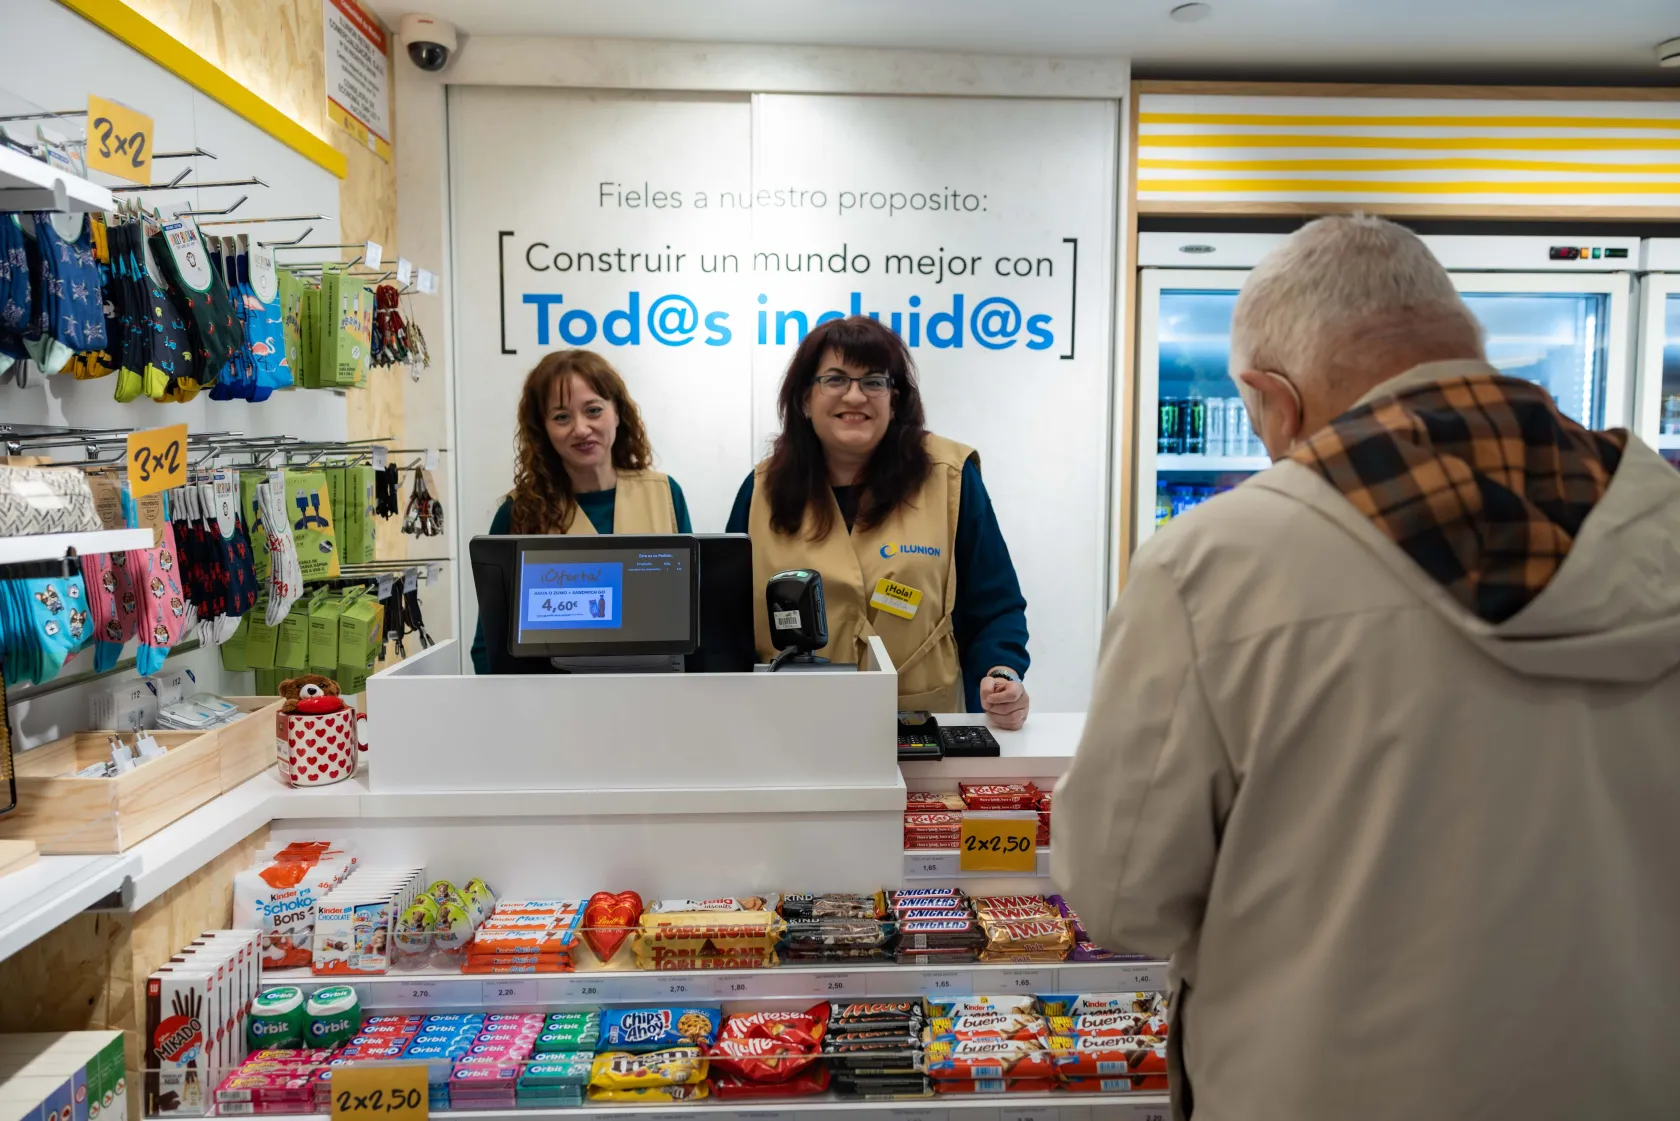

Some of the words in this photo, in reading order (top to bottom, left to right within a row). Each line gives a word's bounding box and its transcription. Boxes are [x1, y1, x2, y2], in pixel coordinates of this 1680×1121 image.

[94, 117, 145, 168] 3x2
[599, 182, 682, 209] Fieles
[694, 191, 708, 209] a
[720, 185, 827, 209] nuestro
[839, 186, 988, 217] proposito:
[525, 242, 686, 273] Construir
[701, 253, 739, 273] un
[753, 243, 870, 274] mundo
[885, 246, 982, 285] mejor
[995, 256, 1053, 278] con
[522, 291, 733, 347] Tod@s
[134, 440, 180, 482] 3x2
[900, 544, 941, 557] ILUNION
[885, 583, 913, 599] ¡Hola!
[541, 598, 578, 613] 4,60€
[964, 835, 1031, 854] 2x2,50
[271, 891, 297, 901] Kinder
[897, 888, 953, 896] SNICKERS
[784, 894, 813, 902] KIND
[899, 898, 957, 907] SNICKERS
[979, 895, 1044, 910] TWIX
[318, 906, 343, 914] Kinder
[907, 909, 966, 918] SNICKERS
[984, 906, 1051, 921] TWIX
[273, 911, 306, 927] Bons
[907, 921, 968, 930] SNICKERS
[998, 920, 1067, 941] TWIX
[266, 990, 294, 1000] Orbit
[319, 989, 348, 999] Orbit
[964, 1003, 985, 1011] Kinder
[1082, 1000, 1107, 1008] Kinder
[369, 1015, 399, 1024] Orbit
[430, 1014, 459, 1022] Orbit
[622, 1011, 663, 1030] Chips
[963, 1016, 1007, 1028] bueno
[1081, 1014, 1131, 1028] bueno
[252, 1021, 289, 1035] Orbit
[312, 1019, 350, 1035] Orbit
[364, 1025, 395, 1033] Orbit
[425, 1024, 455, 1032] Orbit
[487, 1023, 517, 1031] Orbit
[549, 1022, 579, 1031] Orbit
[153, 1017, 202, 1061] MIKADO
[352, 1036, 383, 1045] Orbit
[416, 1035, 448, 1043] Orbit
[479, 1034, 510, 1042] Orbit
[542, 1032, 573, 1041] Orbit
[1082, 1036, 1134, 1048] bueno
[410, 1046, 441, 1054] Orbit
[473, 1044, 505, 1053] Orbit
[962, 1043, 1008, 1053] bueno
[462, 1055, 494, 1064] Orbit
[535, 1052, 566, 1061] Orbit
[456, 1068, 489, 1077] Orbit
[531, 1065, 563, 1073] Orbit
[336, 1088, 421, 1113] 2x2,50
